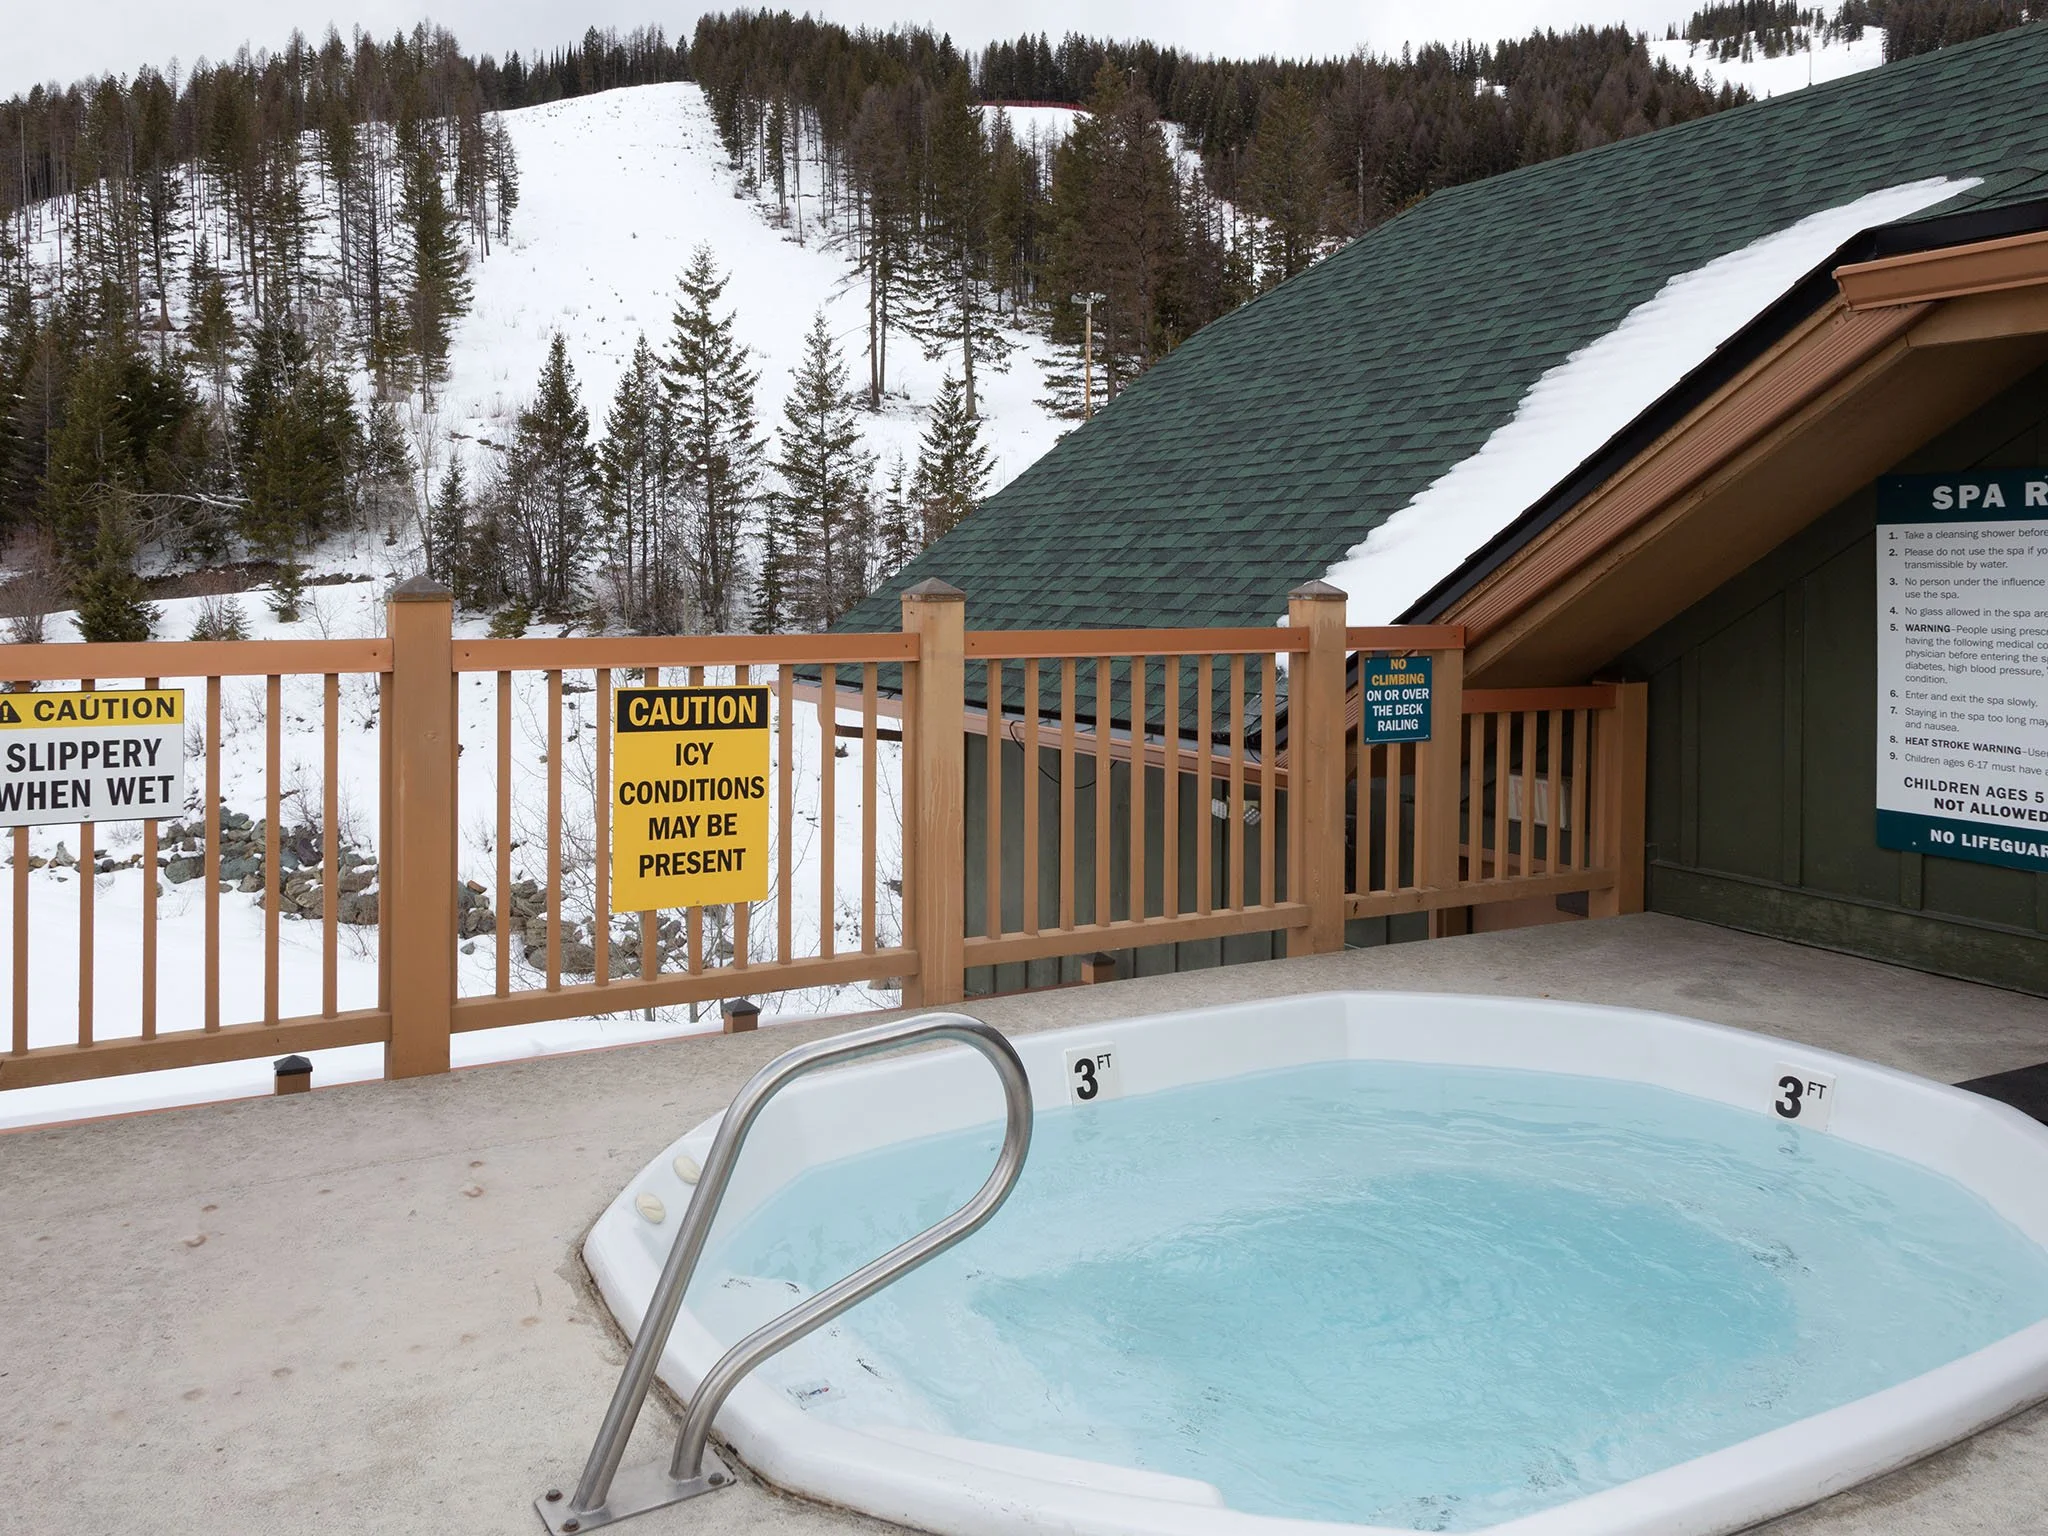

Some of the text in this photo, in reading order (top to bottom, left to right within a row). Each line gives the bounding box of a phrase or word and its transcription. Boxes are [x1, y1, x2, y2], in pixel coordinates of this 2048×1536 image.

[1932, 484, 2006, 510] SPA
[1904, 531, 1924, 539] Take
[1936, 530, 1979, 540] cleansing
[1981, 529, 2015, 538] shower
[1904, 548, 1934, 556] Please
[1936, 548, 1948, 556] do
[1951, 548, 1965, 556] not
[1989, 547, 2004, 555] the
[2007, 548, 2024, 556] spa
[2028, 546, 2034, 555] if
[1904, 561, 2008, 569] transmissible by water.
[1889, 578, 2045, 587] 3. No person under the influence
[1905, 607, 1917, 615] No
[1920, 607, 1943, 617] glass
[1946, 608, 1980, 616] allowed
[1983, 608, 1991, 616] in
[1995, 609, 2010, 617] the
[2013, 610, 2030, 619] spa
[1991, 626, 2016, 637] using
[2019, 628, 2048, 637] presc
[1905, 637, 1934, 647] having
[1953, 638, 1993, 649] following
[1996, 640, 2033, 649] medical
[1905, 650, 1945, 659] physician
[1949, 651, 1977, 660] before
[1980, 652, 2019, 663] entering
[2022, 654, 2038, 662] the
[1390, 659, 1407, 670] NO
[1948, 664, 1967, 674] high
[1971, 665, 1996, 673] blood
[1371, 673, 1425, 686] CLIMBING
[1905, 675, 1948, 684] condition.
[1367, 688, 1429, 701] ON OR OVER
[1890, 690, 2038, 709] 6. Enter and exit the spa slowly.
[34, 697, 175, 721] CAUTION
[628, 695, 757, 727] CAUTION
[1372, 704, 1423, 716] THE DECK
[1890, 706, 2048, 728] 7. Staying in the spa too long may
[1377, 719, 1418, 731] RAILING
[1905, 721, 1959, 732] and nausea.
[1890, 735, 1898, 743] 8.
[1905, 737, 1929, 745] HEAT
[1932, 739, 1970, 750] STROKE
[6, 738, 162, 773] SLIPPERY
[675, 742, 714, 766] ICY
[1890, 752, 1898, 760] 9.
[1905, 753, 1940, 764] Children
[1943, 759, 1965, 768] ages
[1968, 760, 1988, 769] 6-17
[1992, 763, 2015, 772] must
[2019, 765, 2042, 775] have
[0, 775, 174, 812] WHEN WET
[619, 776, 765, 805] CONDITIONS
[1904, 777, 2044, 803] CHILDREN AGES 5
[1934, 798, 2048, 823] NOT ALLOWED
[648, 813, 737, 840] MAY BE
[1931, 829, 1954, 844] NO
[639, 848, 746, 878] PRESENT
[1075, 1053, 1111, 1100] 3 FT
[1775, 1076, 1827, 1118] 3 FT
